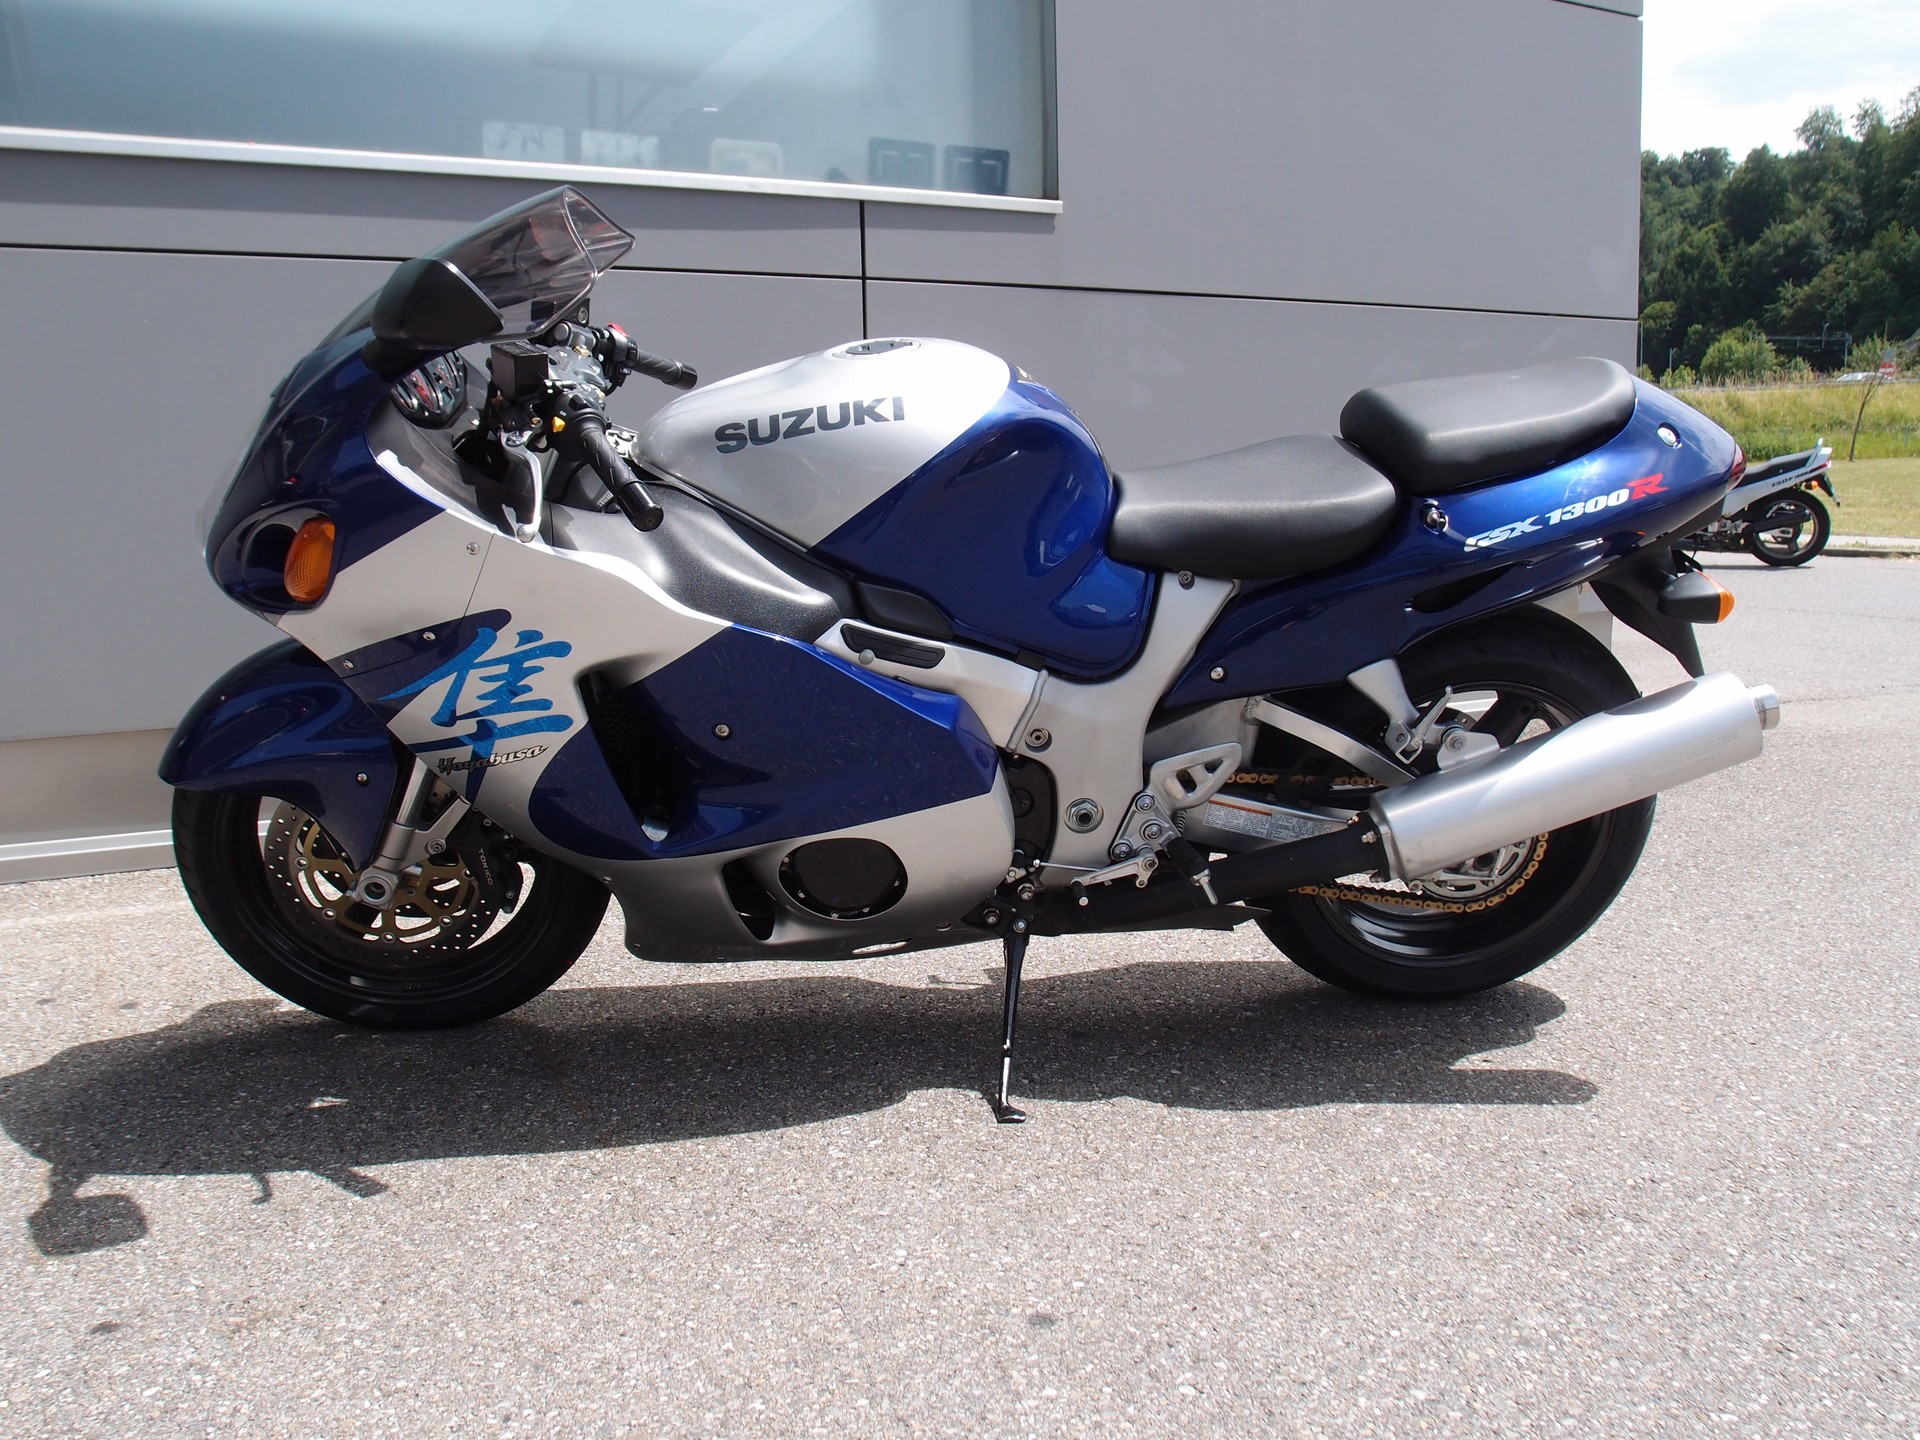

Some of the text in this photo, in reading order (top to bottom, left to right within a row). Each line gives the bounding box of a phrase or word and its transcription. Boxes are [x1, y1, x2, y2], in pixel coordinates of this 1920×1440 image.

[714, 396, 905, 454] SUZUKI
[1463, 515, 1543, 553] GSX
[376, 626, 575, 804] 隼
[436, 745, 550, 776] Hayabusa
[478, 847, 494, 886] TOKICO
